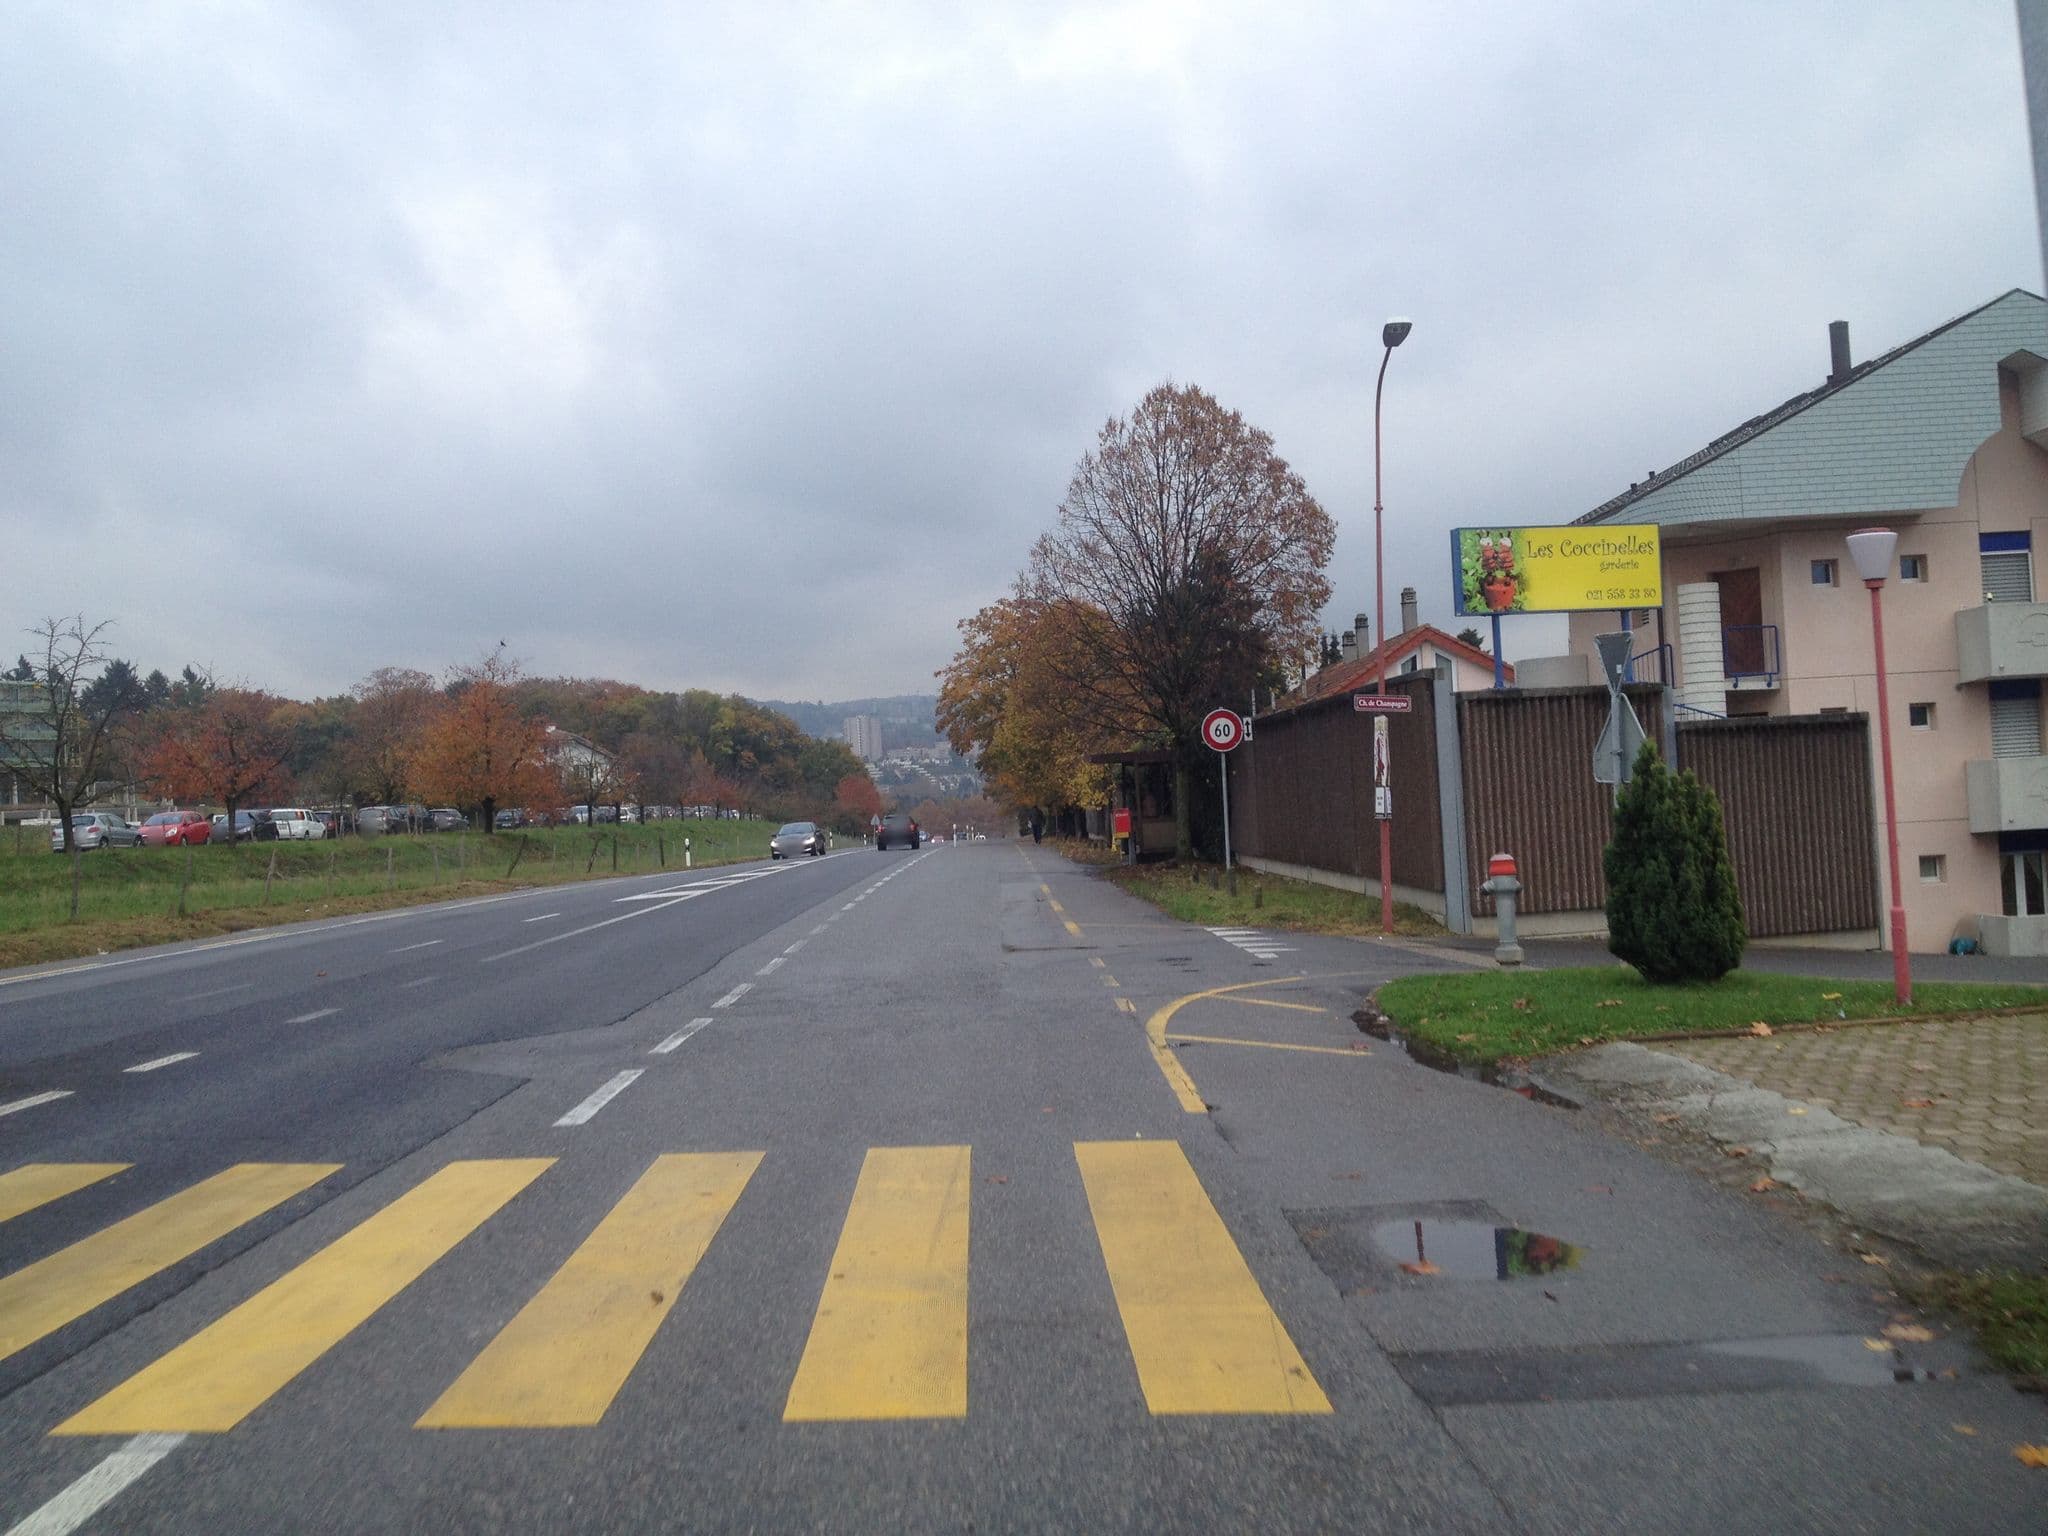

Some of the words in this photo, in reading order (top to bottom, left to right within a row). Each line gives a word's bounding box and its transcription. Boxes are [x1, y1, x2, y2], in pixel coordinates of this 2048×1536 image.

[1527, 541, 1554, 559] Les
[1560, 536, 1654, 558] Coccinelles
[1599, 559, 1640, 574] garderie
[1586, 590, 1603, 601] 021
[1606, 589, 1626, 600] 558
[1375, 699, 1408, 709] Champagne
[1214, 723, 1231, 738] 60
